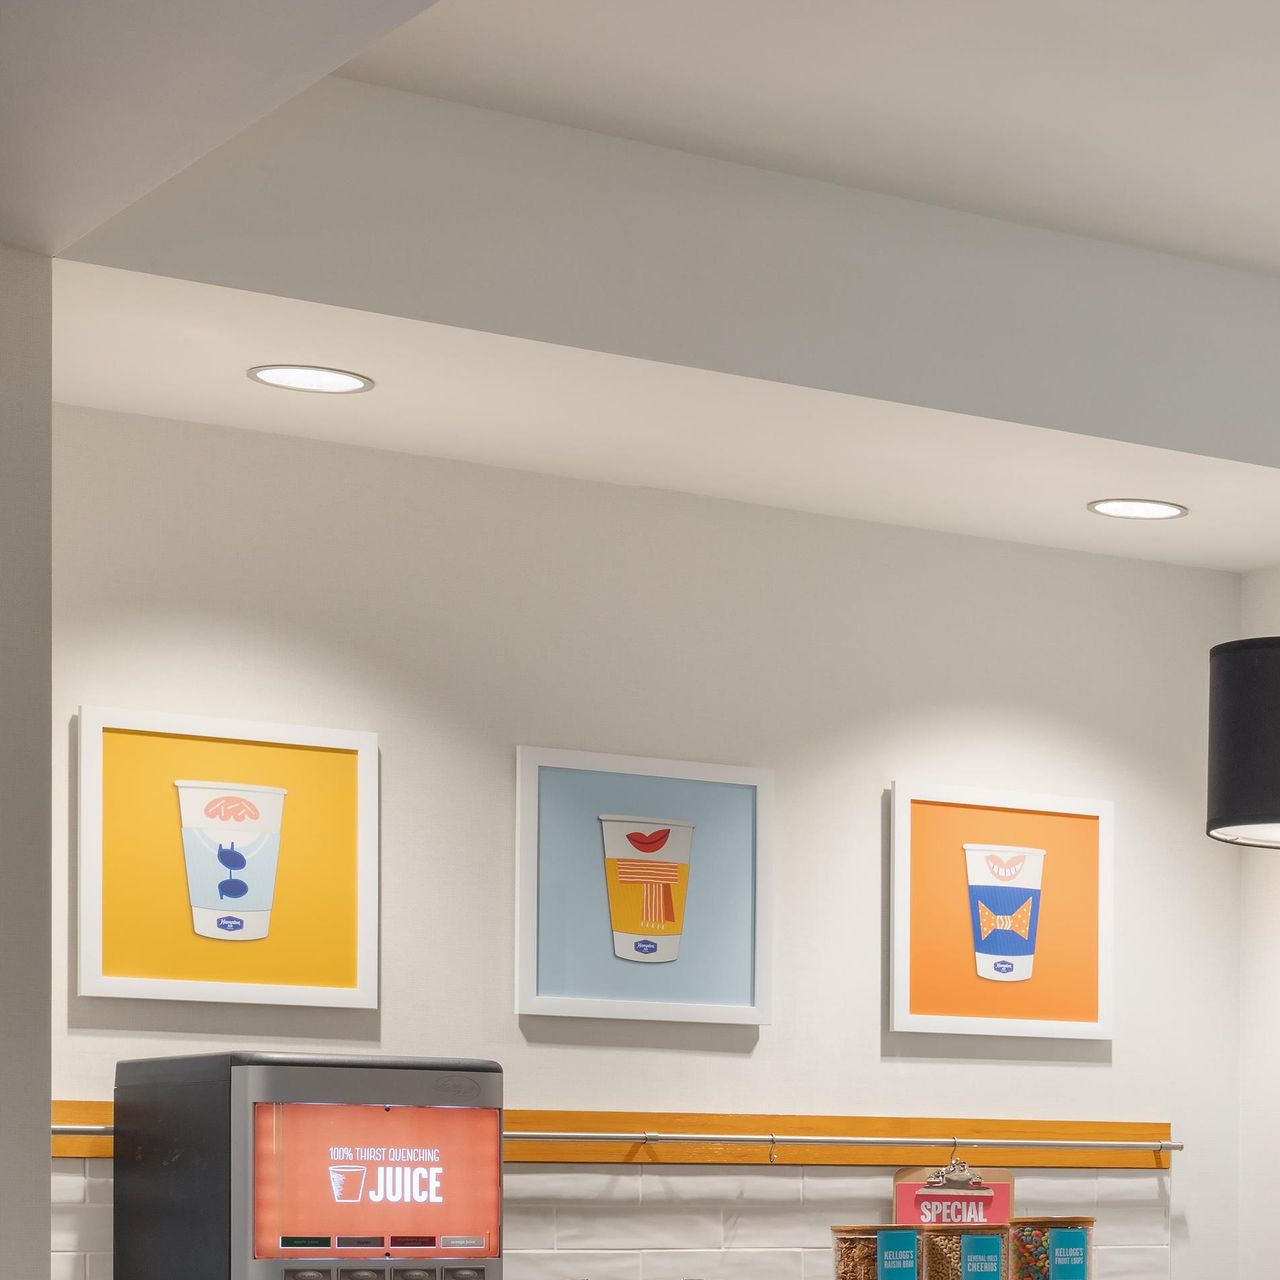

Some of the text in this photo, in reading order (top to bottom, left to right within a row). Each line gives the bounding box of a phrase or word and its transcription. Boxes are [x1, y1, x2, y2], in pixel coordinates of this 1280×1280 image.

[328, 1146, 440, 1162] 100% THIRST QUENCHING
[368, 1166, 443, 1203] JUICE
[920, 1200, 988, 1223] SPECIAL
[884, 1250, 914, 1260] KELLOGG'S
[967, 1262, 998, 1272] CHEERIOS
